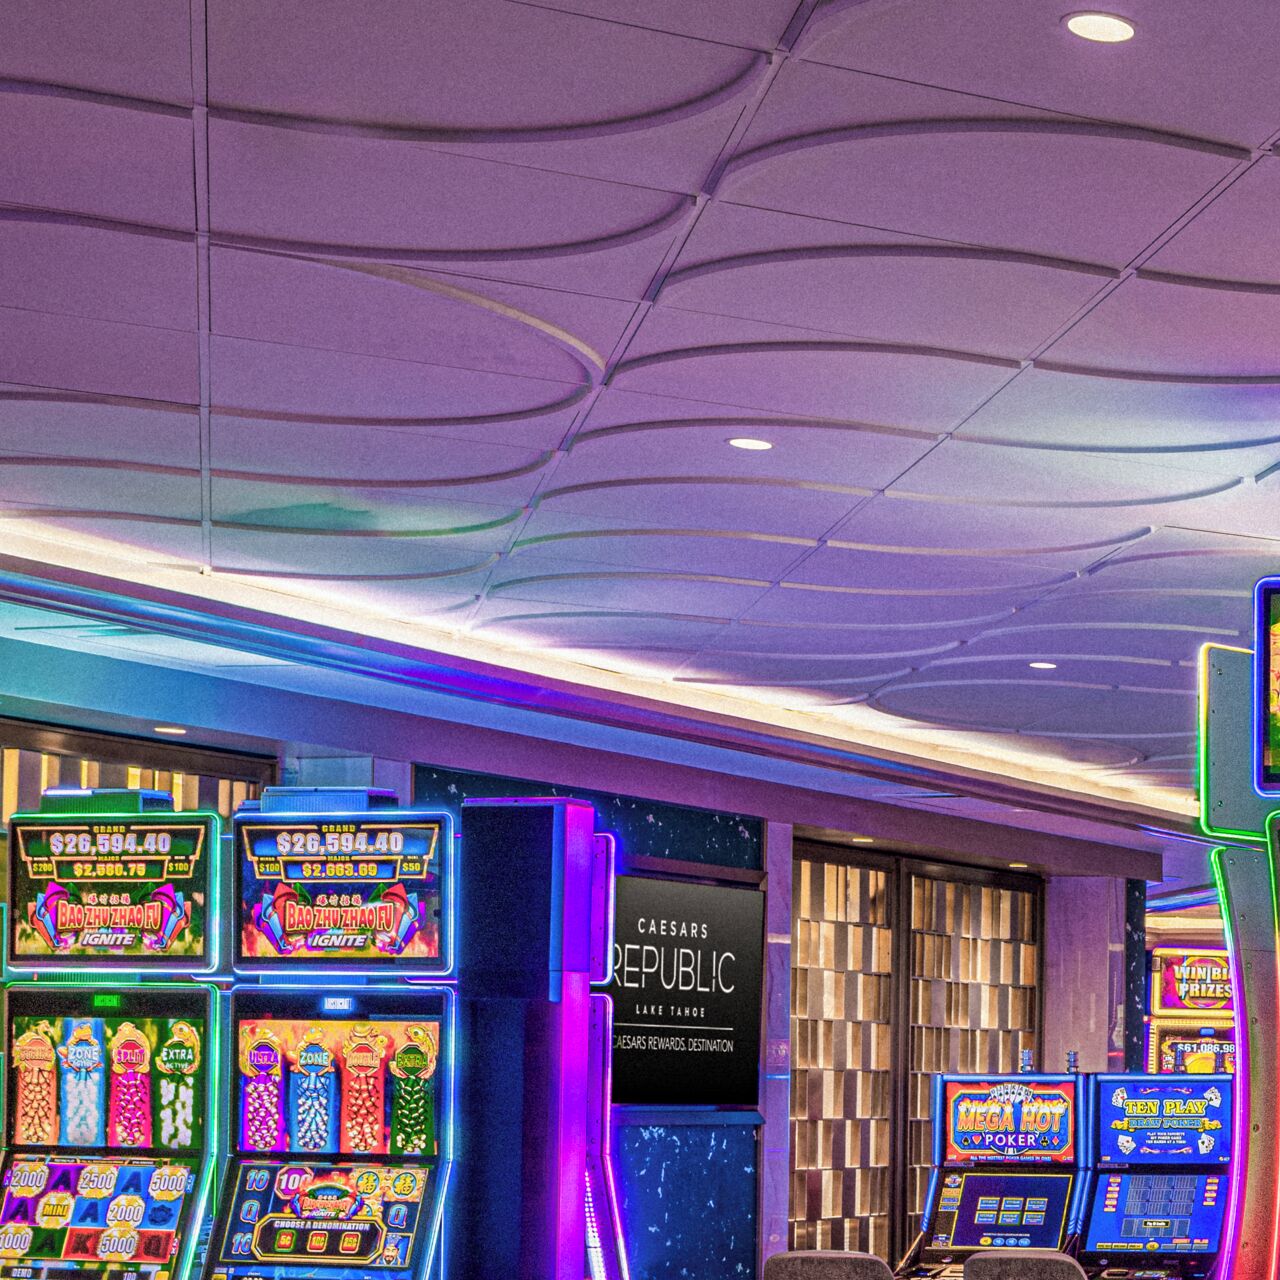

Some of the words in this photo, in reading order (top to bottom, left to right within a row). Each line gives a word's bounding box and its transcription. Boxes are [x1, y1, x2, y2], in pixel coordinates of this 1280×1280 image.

[50, 833, 171, 855] $26,594.40
[277, 832, 403, 854] $26,594.40
[57, 900, 83, 929] BAO
[85, 905, 110, 927] ZHU
[110, 905, 143, 928] ZHAO
[144, 902, 161, 929] FU
[285, 900, 313, 931] BAO
[313, 905, 340, 929] ZHU
[340, 904, 375, 929] ZHAO
[375, 901, 394, 931] FU
[638, 918, 708, 938] CAESARS
[82, 933, 135, 946] IGNITE
[312, 935, 367, 947] IGNITE
[1174, 966, 1207, 980] WIN
[1211, 968, 1230, 980] BI
[636, 1004, 662, 1015] LAKE
[671, 1006, 705, 1018] TAHOE
[688, 1039, 733, 1052] DESTINATION
[1178, 1044, 1235, 1053] $61,086.98
[68, 1048, 99, 1061] ZONE
[117, 1049, 144, 1063] SPLIT
[162, 1048, 193, 1062] EXTRA
[1125, 1100, 1158, 1115] TEN
[1164, 1100, 1208, 1115] PLAY
[958, 1101, 1014, 1132] MEGA
[1020, 1101, 1067, 1132] HOT
[1129, 1119, 1161, 1128] DRAW
[1163, 1118, 1202, 1128] POKER
[985, 1134, 1036, 1146] POKER
[274, 1221, 304, 1229] CHOOSE
[313, 1222, 370, 1230] DENOMINATION
[12, 1269, 32, 1277] DEMO
[123, 1272, 136, 1280] 100
